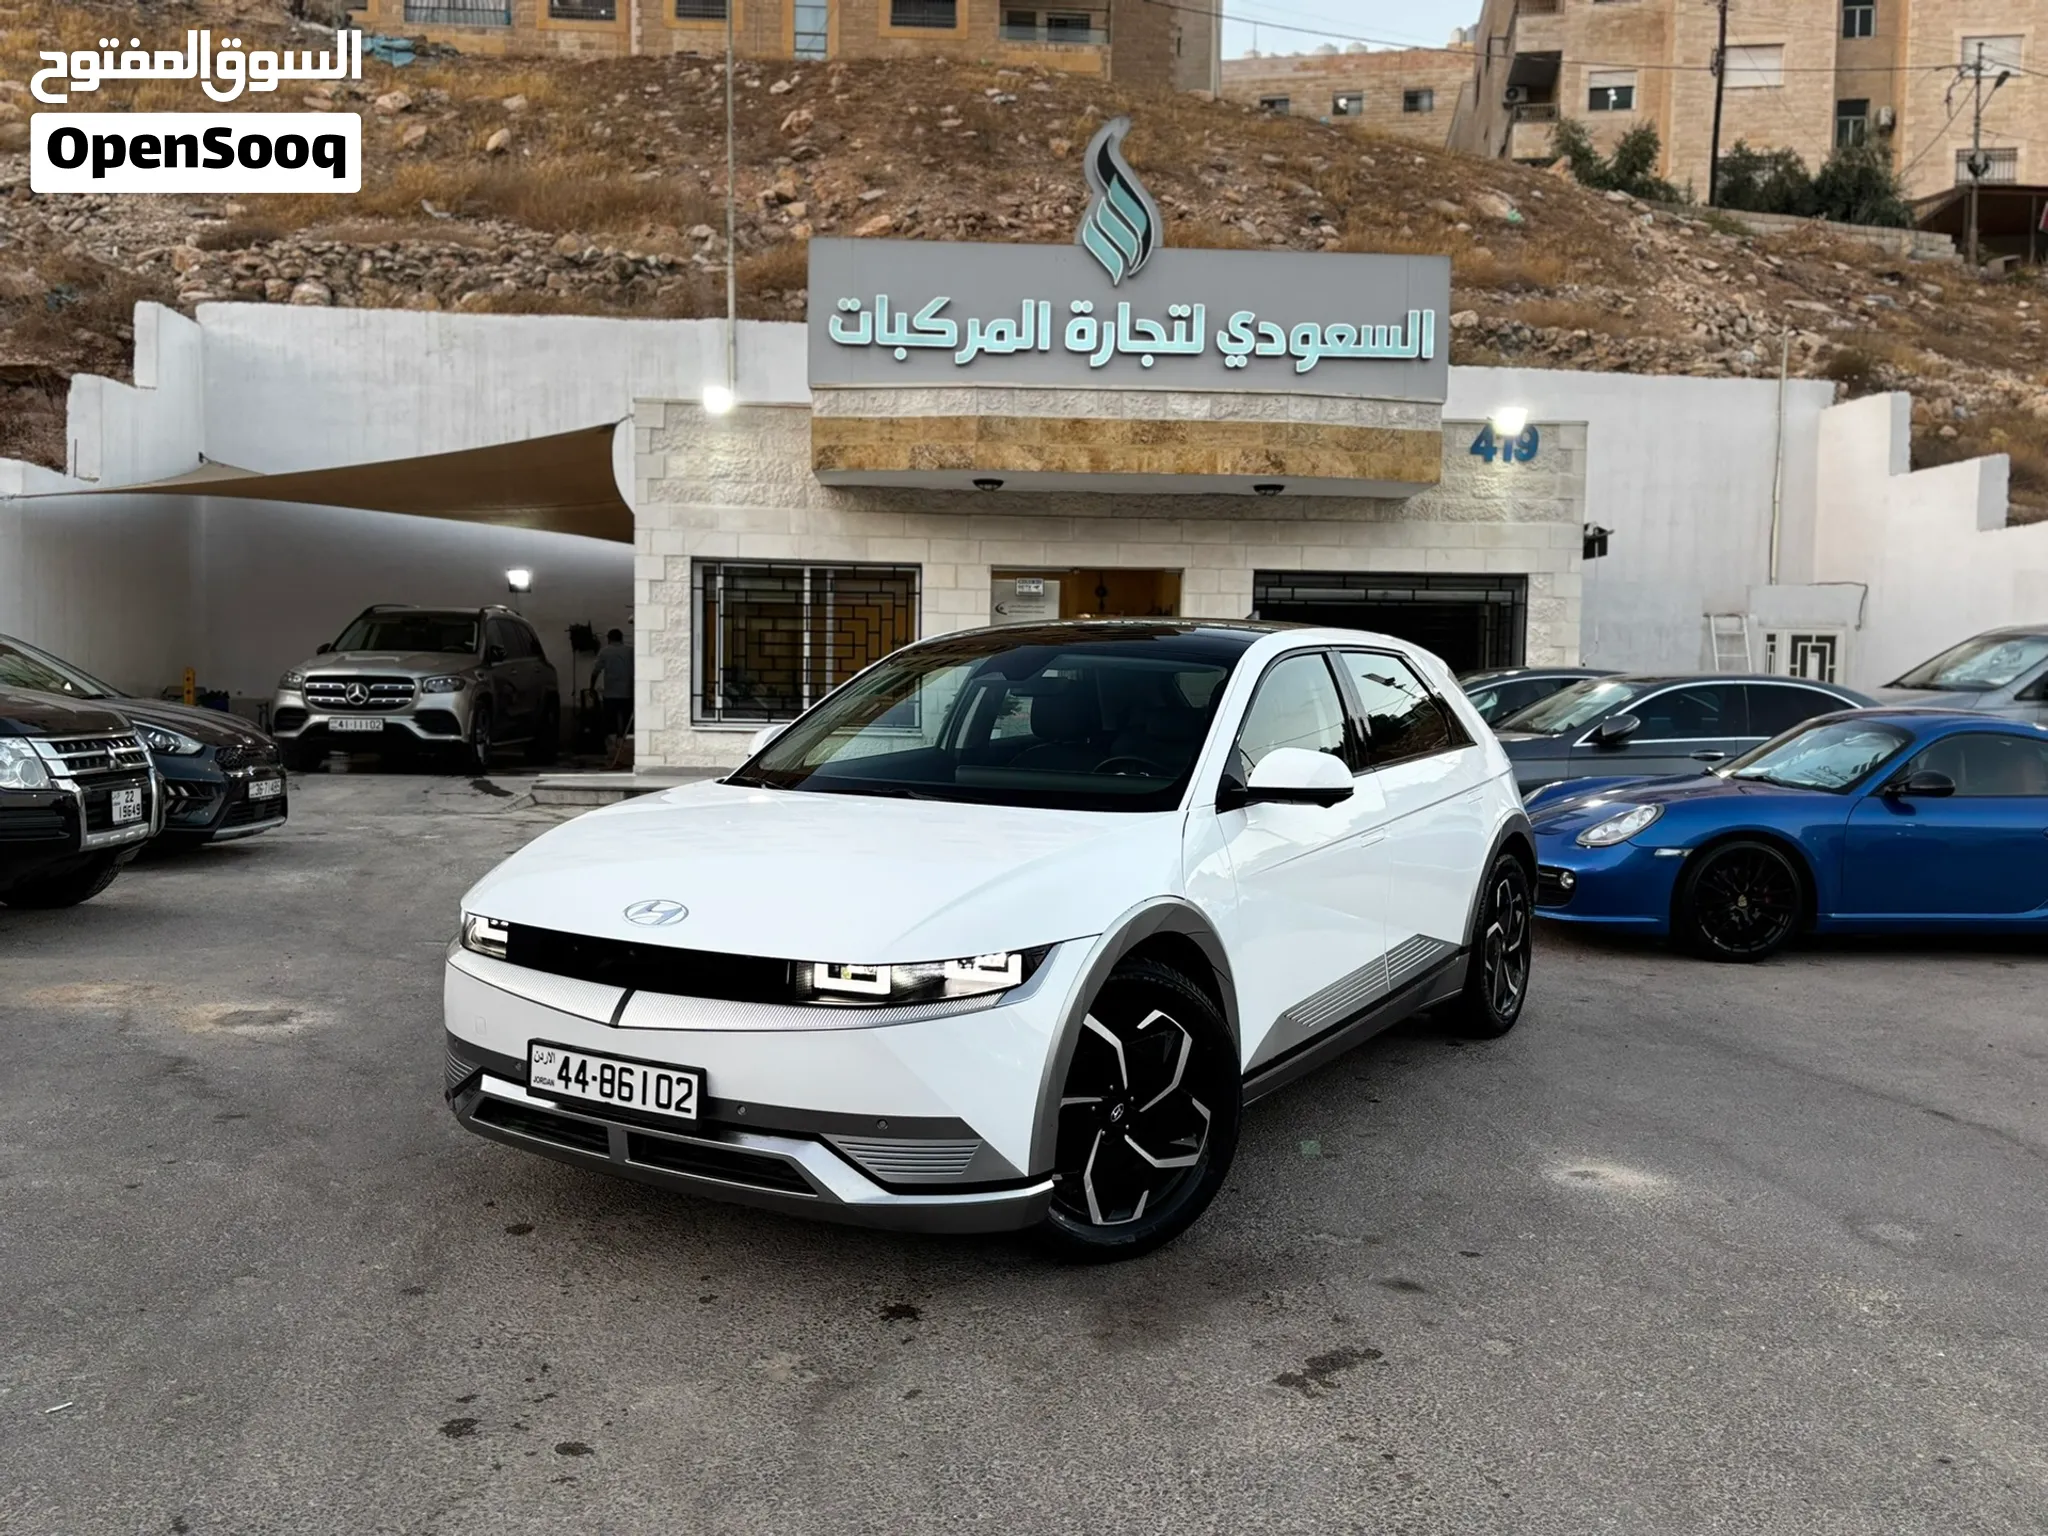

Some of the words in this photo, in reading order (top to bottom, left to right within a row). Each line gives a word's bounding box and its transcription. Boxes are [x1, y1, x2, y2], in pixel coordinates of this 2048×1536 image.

[828, 294, 1052, 365] المركبات
[1065, 299, 1206, 368] لتجارة
[1216, 308, 1435, 373] السعودي
[1469, 422, 1540, 463] 419
[125, 790, 134, 803] 22
[532, 1075, 555, 1087] JORDAN
[556, 1055, 693, 1114] 44-86102
